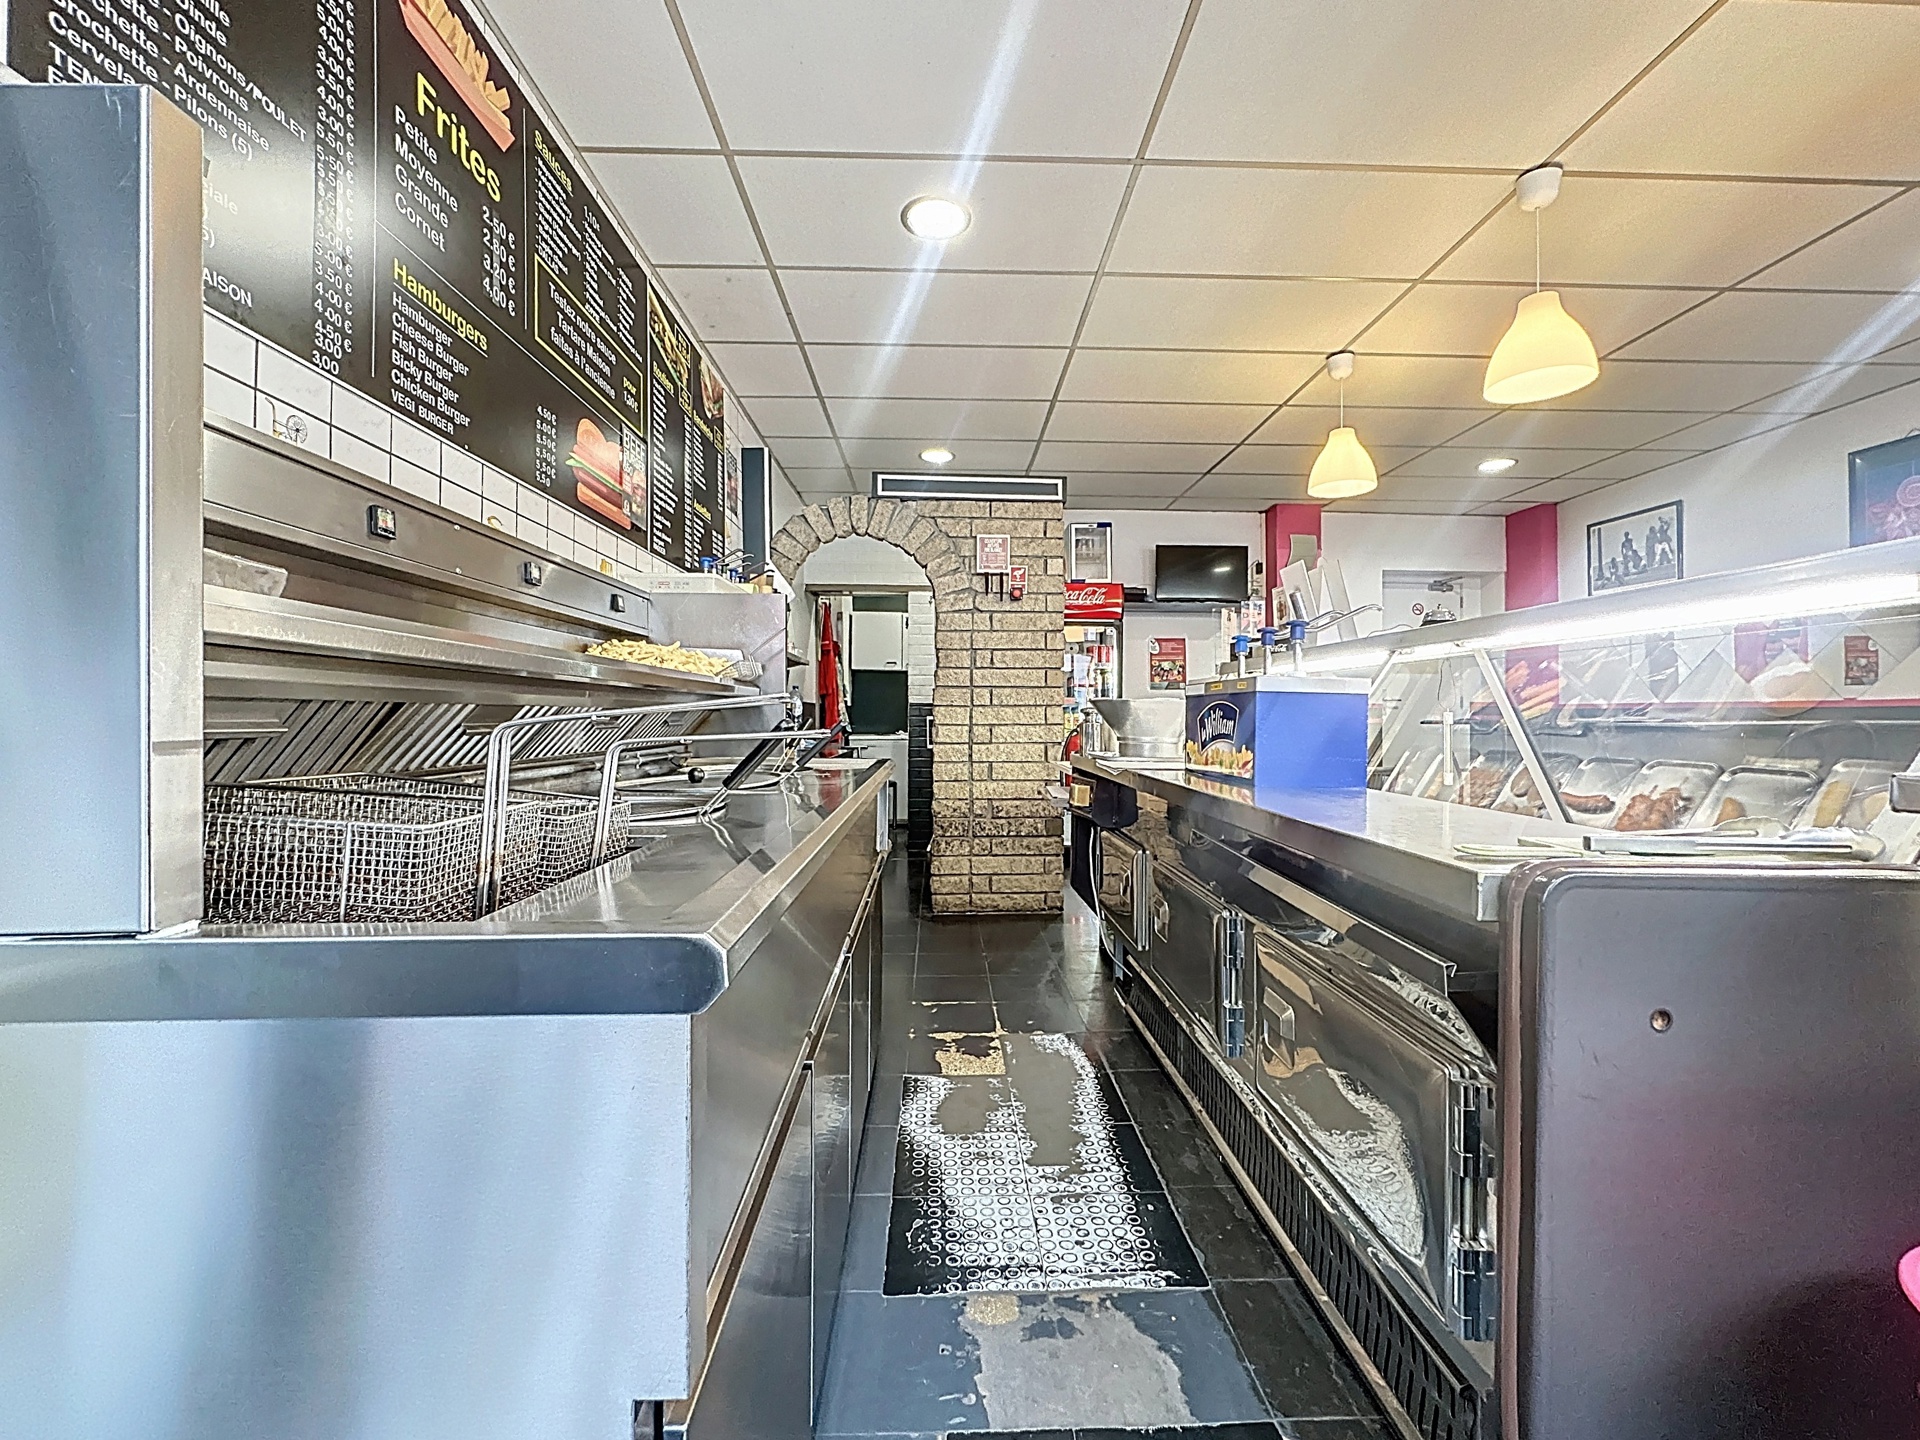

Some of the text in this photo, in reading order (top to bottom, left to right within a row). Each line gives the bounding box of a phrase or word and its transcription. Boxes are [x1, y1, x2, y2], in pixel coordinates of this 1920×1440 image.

[316, 3, 344, 43] 5.00
[318, 25, 345, 61] 4.00
[175, 35, 249, 112] Poivrons
[175, 13, 307, 142] Oignons/POULET
[316, 62, 345, 99] 3.50
[317, 45, 345, 80] 3.00
[174, 62, 270, 151] Ardennaise
[316, 85, 345, 118] 4.00
[174, 84, 227, 139] Pilons
[232, 132, 252, 161] (5)
[316, 121, 344, 156] 5.50
[317, 105, 345, 137] 3.00
[394, 104, 438, 165] Petite
[416, 71, 501, 203] Frites
[316, 144, 344, 175] 5.50
[317, 162, 344, 195] 5.50
[394, 132, 459, 213] Moyenne
[534, 129, 573, 193] Sauces
[394, 163, 449, 229] Grande
[394, 191, 446, 252] Cornet
[482, 205, 507, 241] 2.50
[314, 241, 343, 270] 5.00
[482, 227, 507, 263] 2.80
[203, 267, 253, 308] AISON
[483, 253, 507, 286] 3.20
[314, 281, 342, 309] 4.00
[392, 257, 489, 352] Hamburgers
[482, 277, 507, 309] 4,00
[314, 298, 342, 328] 4.00
[392, 291, 453, 348] Hamburger
[549, 280, 577, 320] Testez
[576, 310, 597, 345] notre
[596, 332, 617, 366] sauce
[314, 319, 342, 347] 4.50
[314, 332, 342, 360] 3.00
[392, 312, 470, 377] Cheese Burger
[550, 326, 574, 360] faites
[556, 311, 611, 378] Tartare Maison
[311, 350, 340, 375] 3,00
[392, 329, 454, 384] Fish Burger
[391, 348, 460, 404] Bicky Burger
[623, 375, 637, 397] pour
[391, 369, 471, 428] Chicken Burger
[391, 388, 455, 436] VEGI BURGER
[623, 428, 646, 459] BEEF
